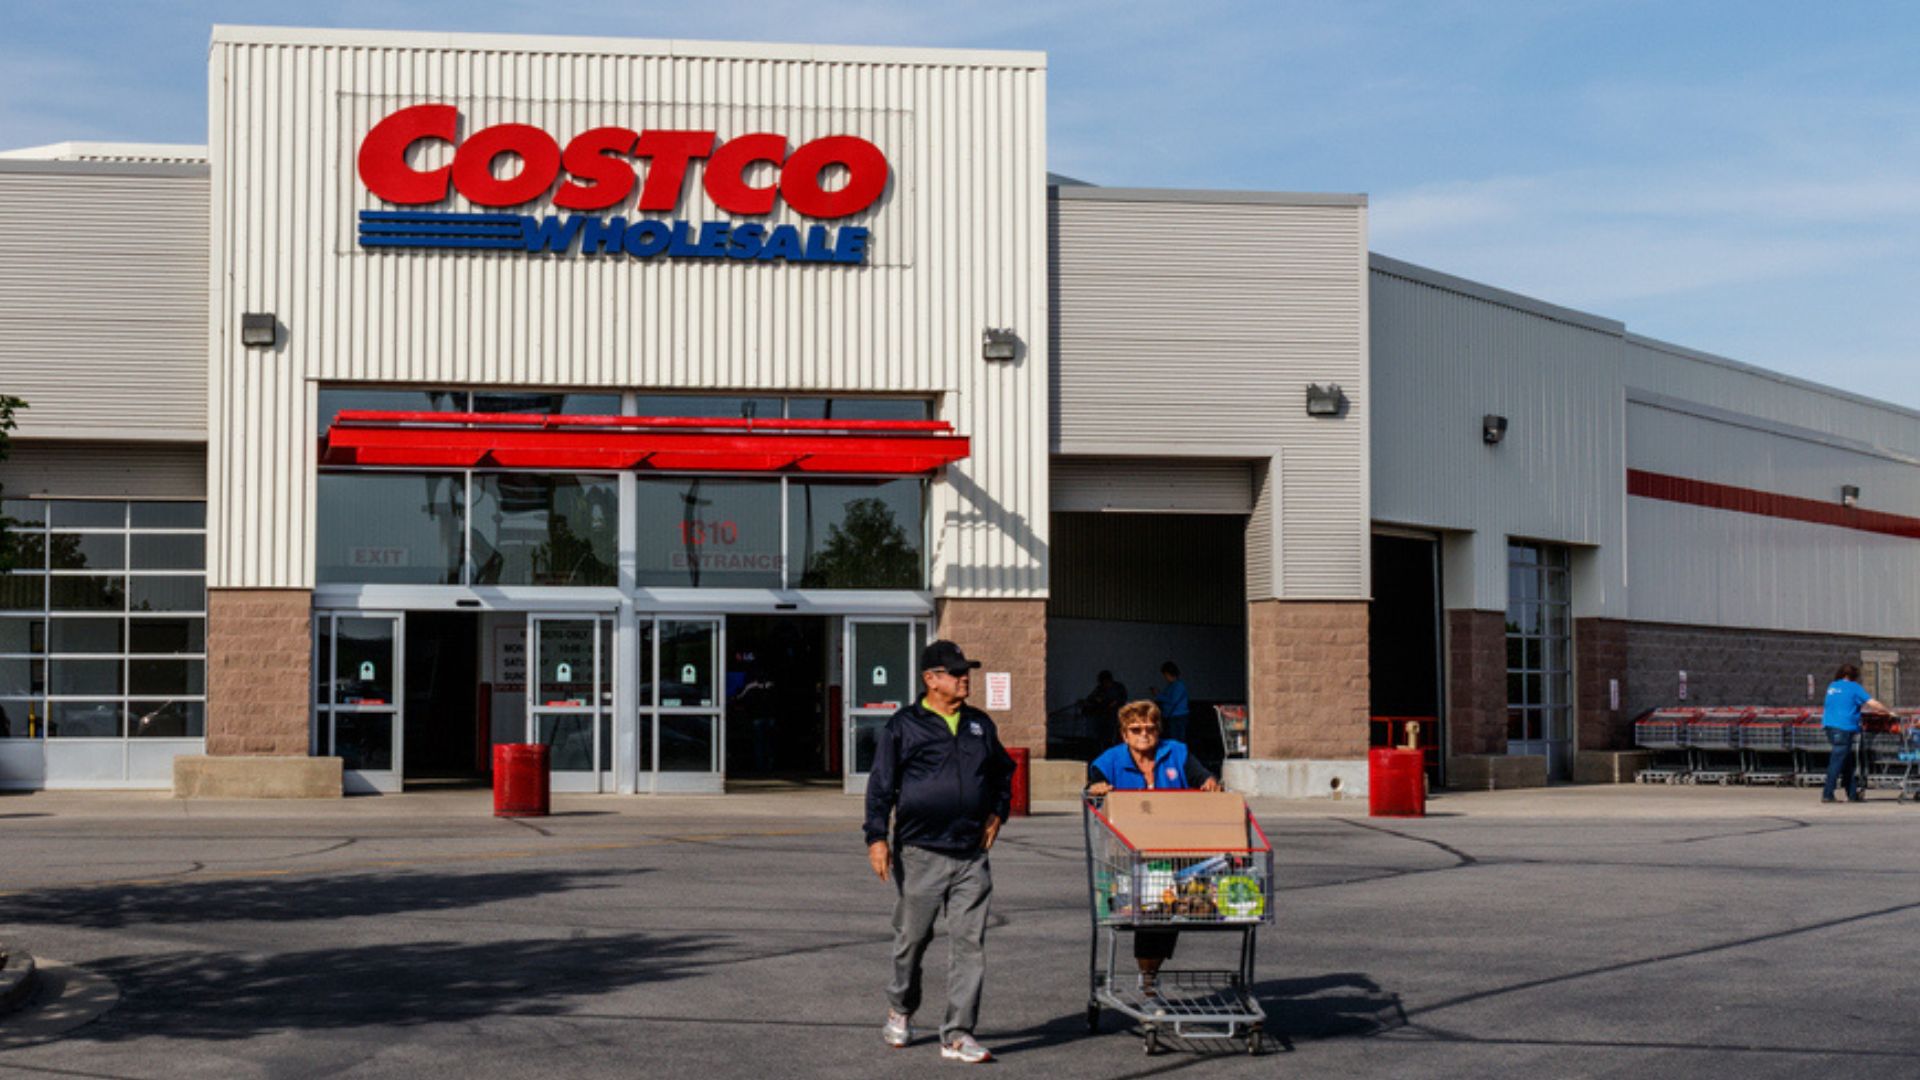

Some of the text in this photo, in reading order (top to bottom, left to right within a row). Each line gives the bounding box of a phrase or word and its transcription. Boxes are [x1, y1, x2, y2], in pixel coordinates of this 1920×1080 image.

[357, 103, 889, 219] COSTCO
[520, 214, 871, 263] WHOLESALE
[677, 519, 737, 545] 1310
[355, 548, 403, 564] EXIT
